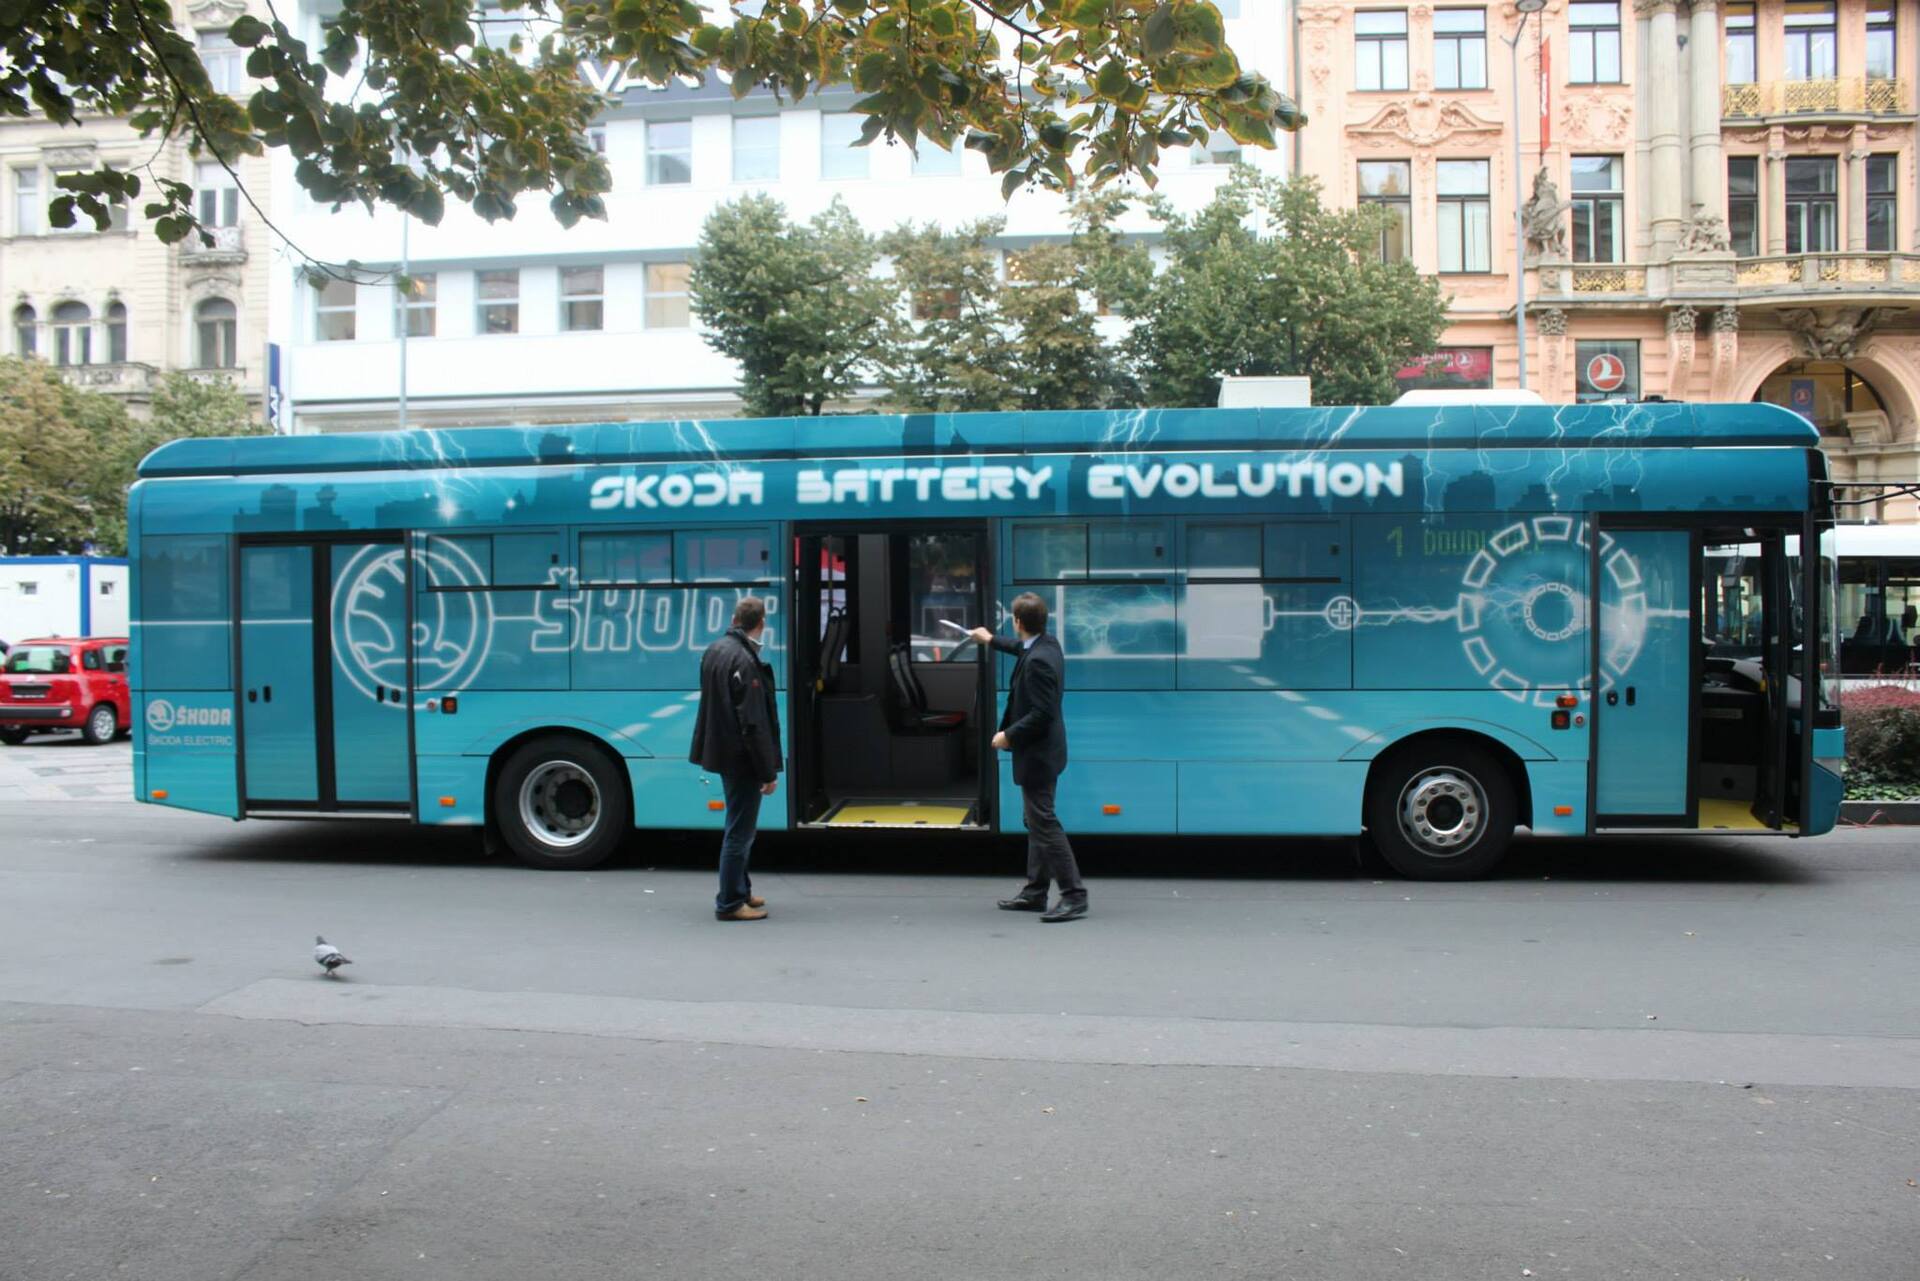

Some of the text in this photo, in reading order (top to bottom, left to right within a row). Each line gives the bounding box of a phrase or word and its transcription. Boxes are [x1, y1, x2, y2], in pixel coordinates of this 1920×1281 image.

[590, 462, 1404, 509] SKODA BATTERY EVOLUTION
[176, 705, 231, 726] ŠKODA
[183, 735, 232, 746] ELECTRIC
